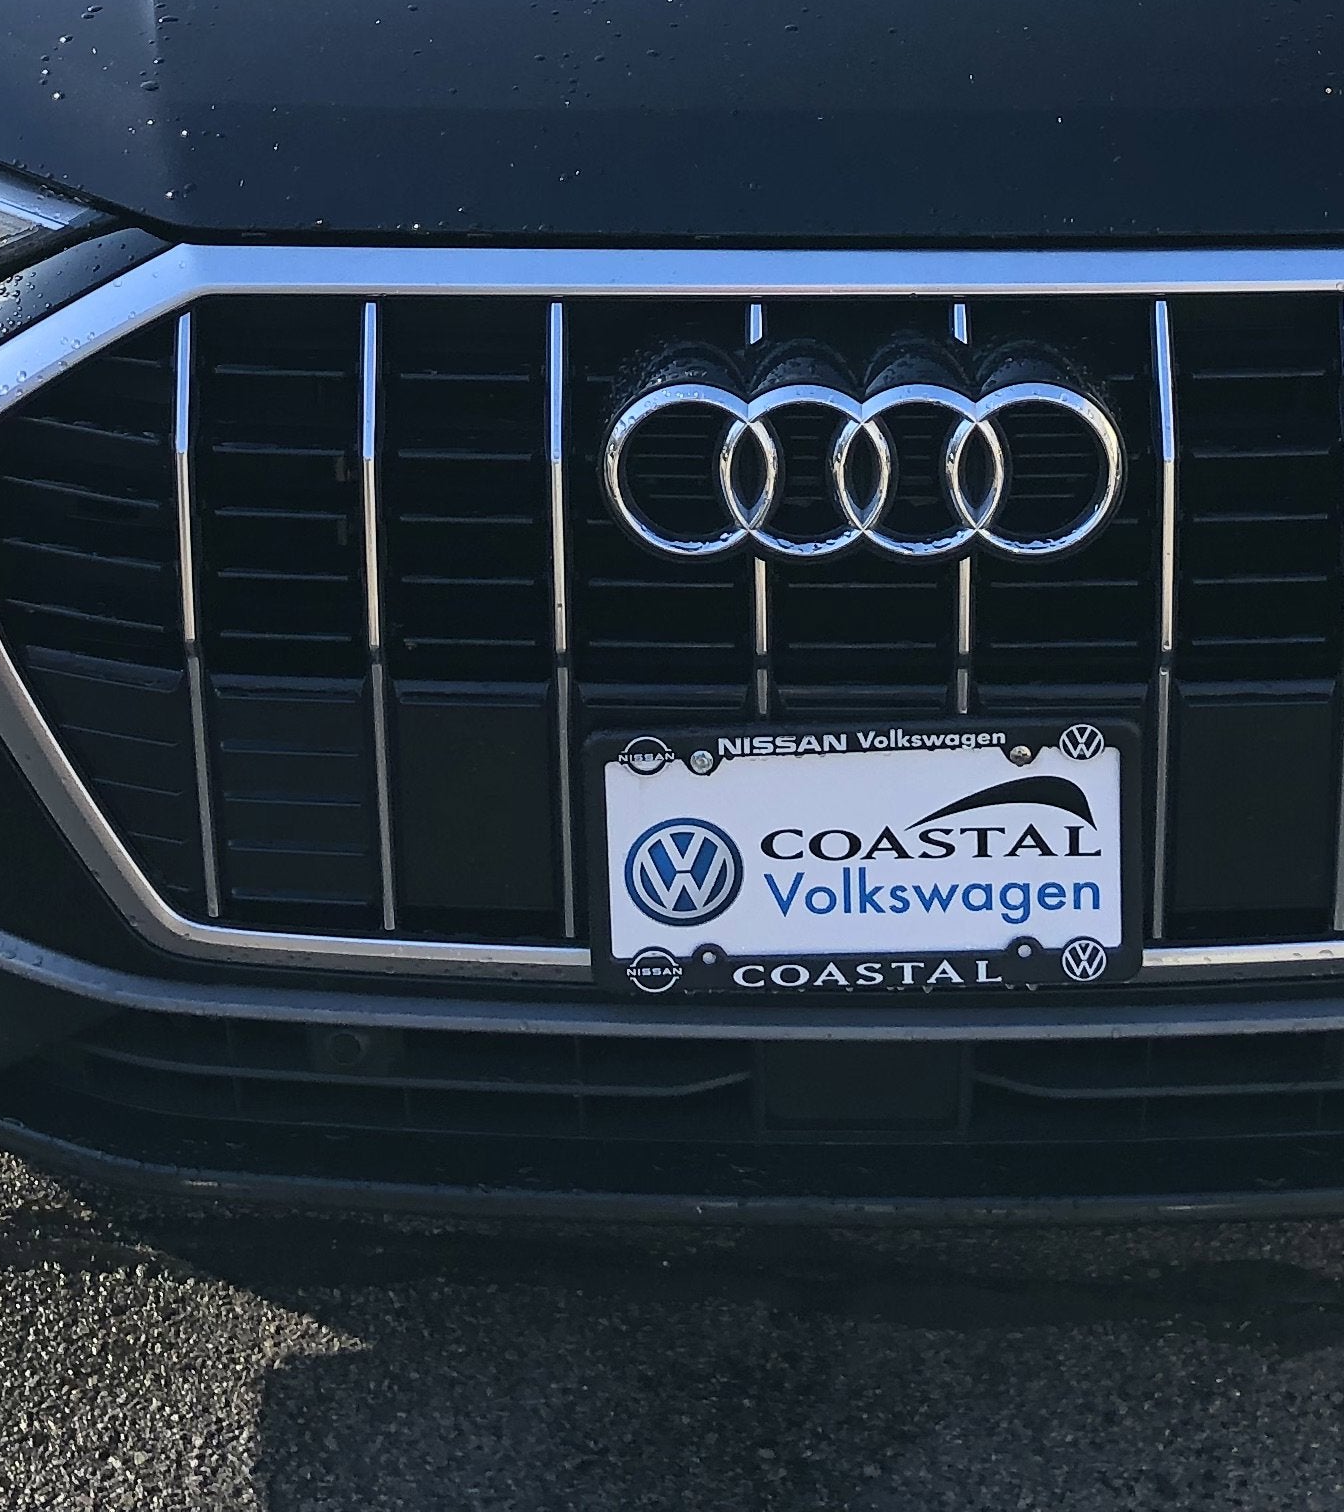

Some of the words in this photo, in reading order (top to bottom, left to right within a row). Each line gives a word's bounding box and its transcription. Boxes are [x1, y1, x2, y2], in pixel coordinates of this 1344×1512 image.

[717, 733, 848, 756] NISSAN
[856, 728, 1007, 752] Volkswagen
[618, 751, 675, 763] NISSAN
[759, 824, 1103, 861] COASTAL
[763, 866, 1102, 925] Volkswagen
[625, 966, 683, 977] NISSAN
[732, 959, 1003, 988] COASTAL
